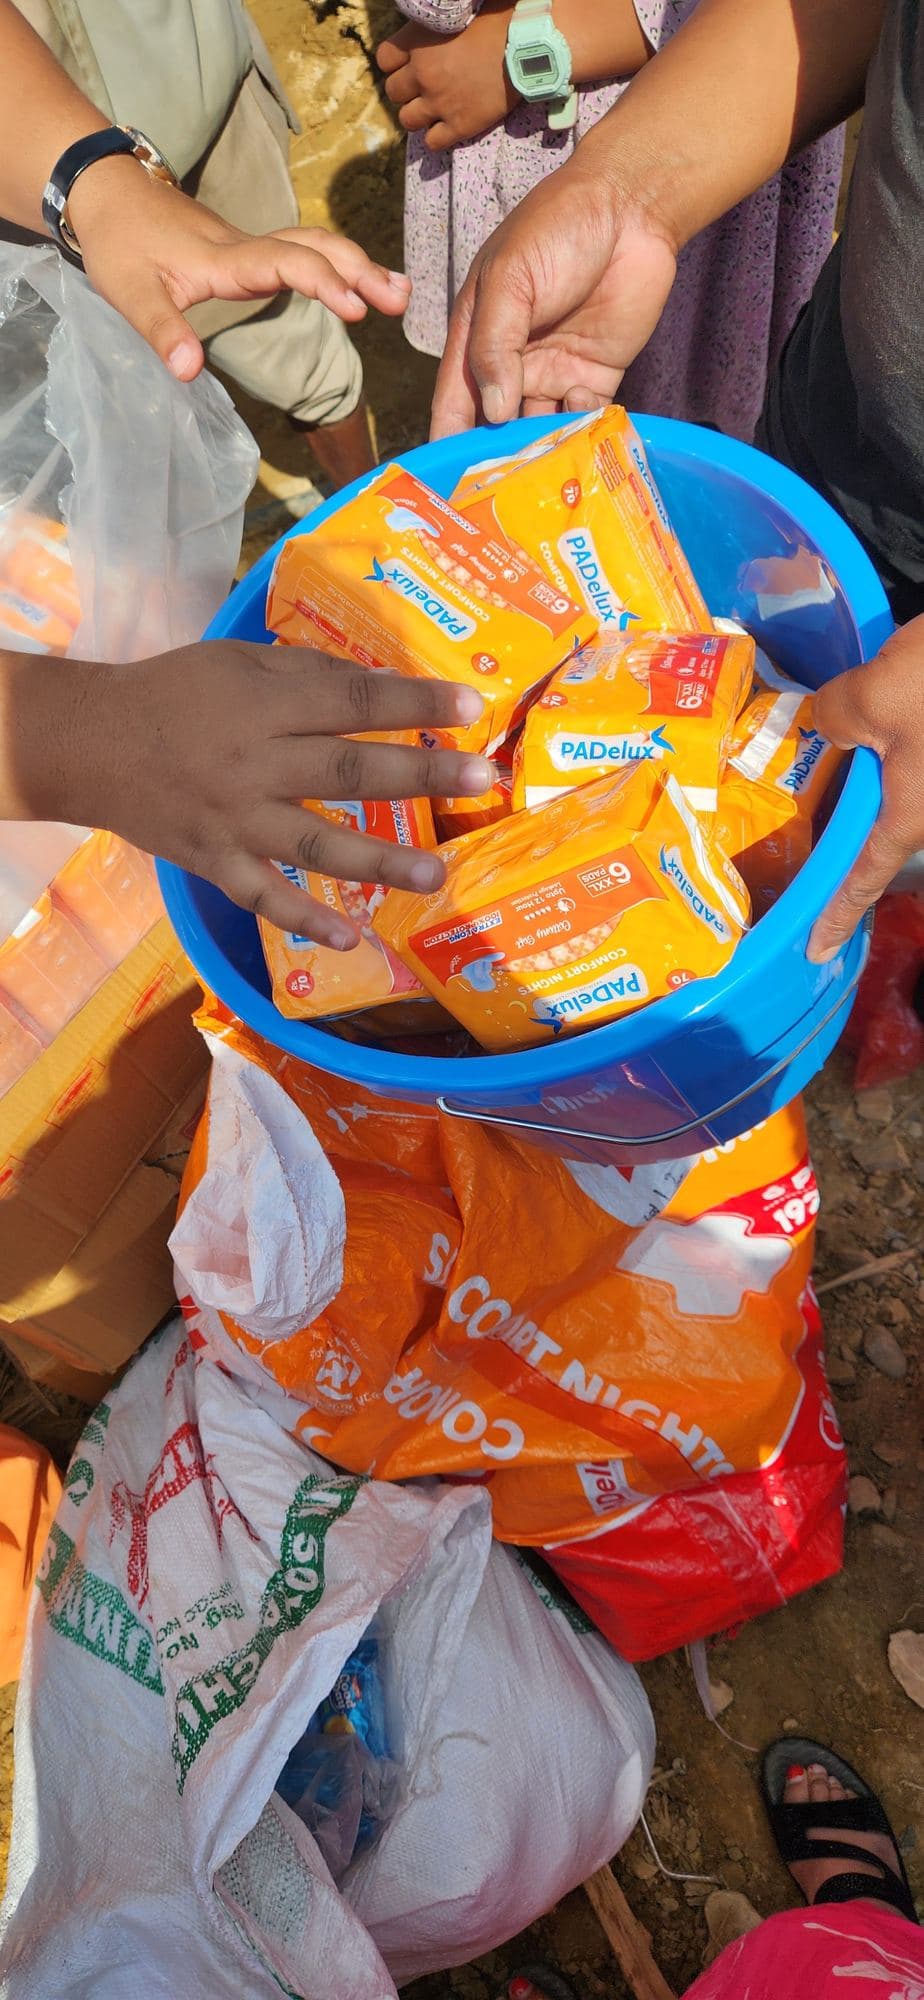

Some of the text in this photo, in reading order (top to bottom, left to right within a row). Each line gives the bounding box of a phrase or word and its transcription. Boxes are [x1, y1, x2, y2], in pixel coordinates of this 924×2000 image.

[563, 487, 578, 503] 70
[400, 545, 438, 580] NIGHTS
[566, 535, 617, 623] PADelux
[386, 568, 468, 636] PADelux
[440, 577, 490, 622] COMFORT
[552, 595, 572, 615] 6
[478, 653, 495, 669] 70
[550, 695, 562, 706] 70
[677, 692, 703, 710] 6
[560, 740, 655, 762] PADelux
[784, 737, 826, 792] PADelux
[581, 868, 609, 884] PADS
[608, 861, 633, 885] 6
[548, 887, 567, 900] Upto
[587, 876, 614, 897] XXL
[514, 899, 535, 913] Hour
[668, 861, 727, 936] PADelux
[537, 920, 573, 942] Cottony
[519, 948, 628, 996] COMFORT NIGHTS
[671, 974, 690, 986] 70
[300, 975, 309, 991] 70
[546, 972, 642, 1017] PADelux
